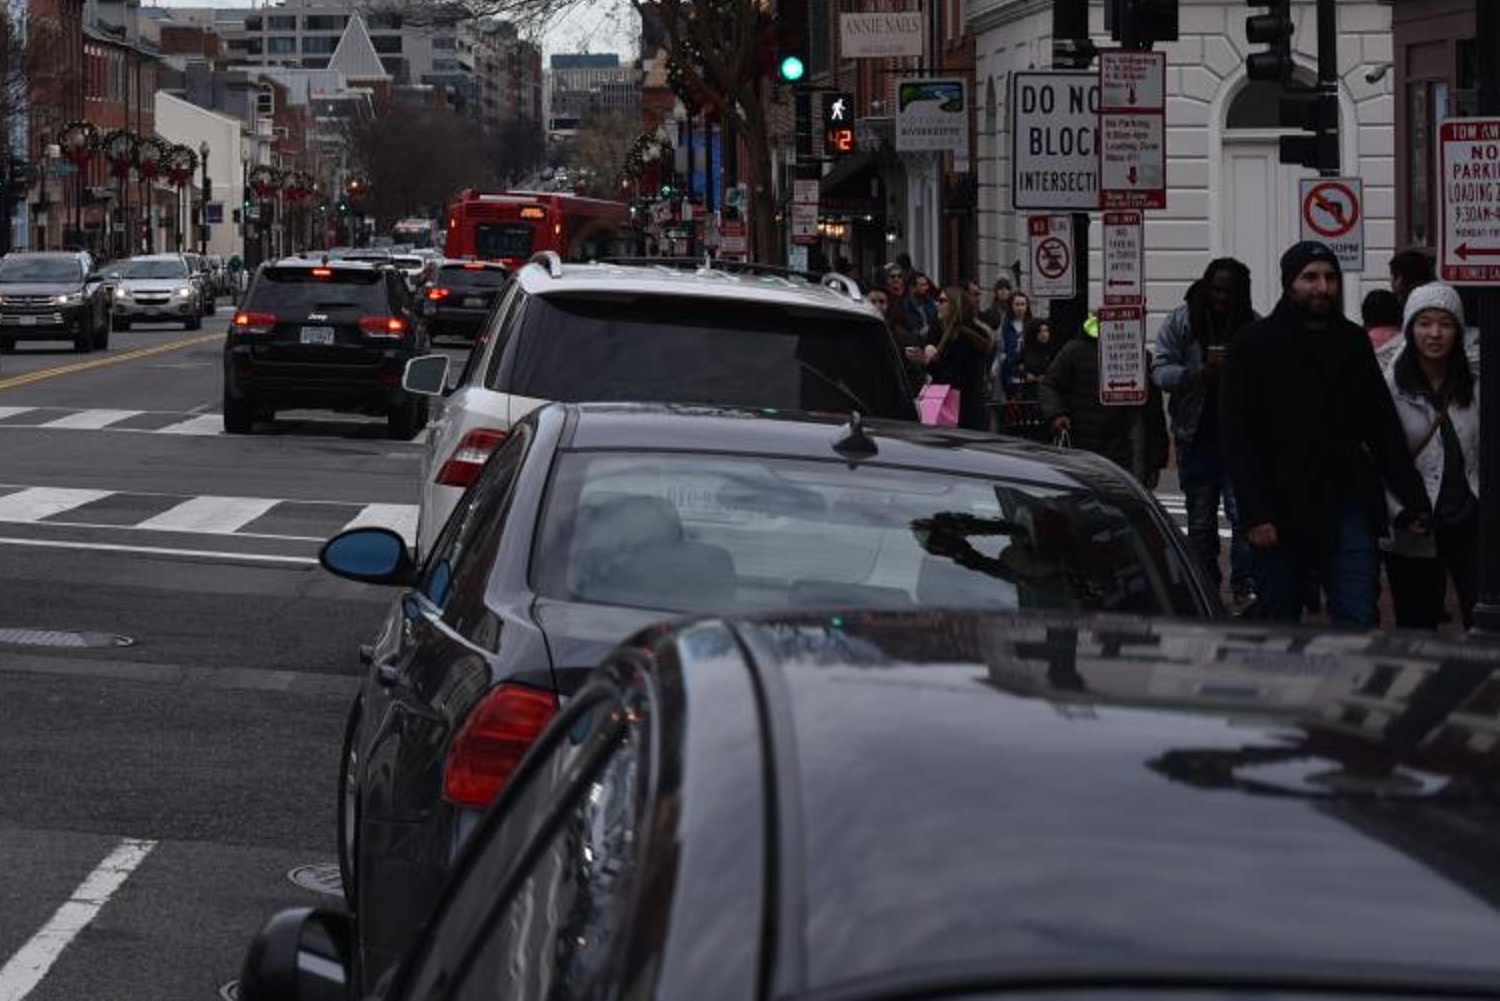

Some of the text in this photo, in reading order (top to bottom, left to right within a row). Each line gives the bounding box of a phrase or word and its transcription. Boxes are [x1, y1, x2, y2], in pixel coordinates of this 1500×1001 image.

[845, 16, 919, 35] ANNIE NAILS
[1022, 85, 1100, 114] DO NO
[1453, 123, 1500, 141] TOW AW
[1471, 145, 1498, 160] NO
[1453, 163, 1500, 180] PARKI
[1019, 171, 1097, 192] INTERSECTI
[1448, 183, 1493, 203] LOADING
[307, 313, 329, 322] Jeep
